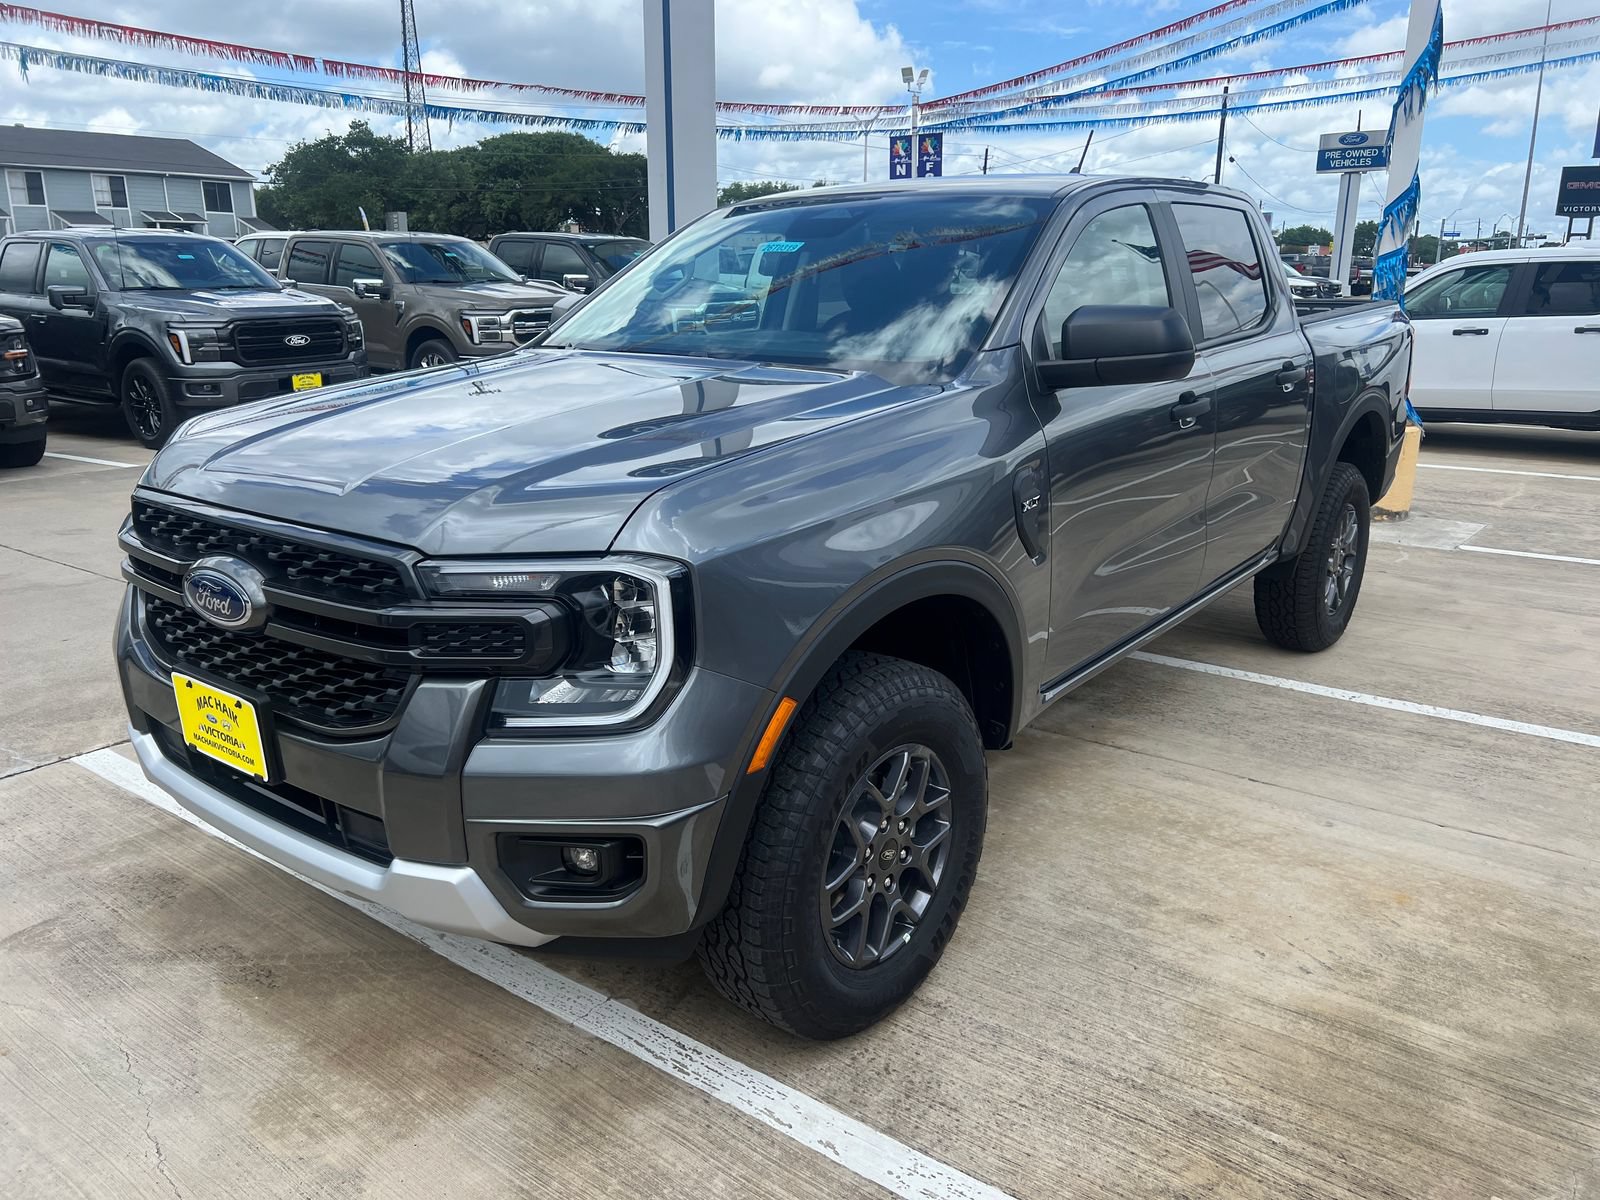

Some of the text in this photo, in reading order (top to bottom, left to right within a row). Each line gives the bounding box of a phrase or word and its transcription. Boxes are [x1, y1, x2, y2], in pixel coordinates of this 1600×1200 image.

[1325, 148, 1379, 160] PRE-OWNED
[1330, 158, 1372, 168] VEHICLES
[1023, 495, 1041, 512] XLT
[196, 695, 240, 728] MAC HAIK
[203, 725, 240, 749] VICTORIA
[193, 732, 256, 767] MACHAIKVICTORIA.COM
